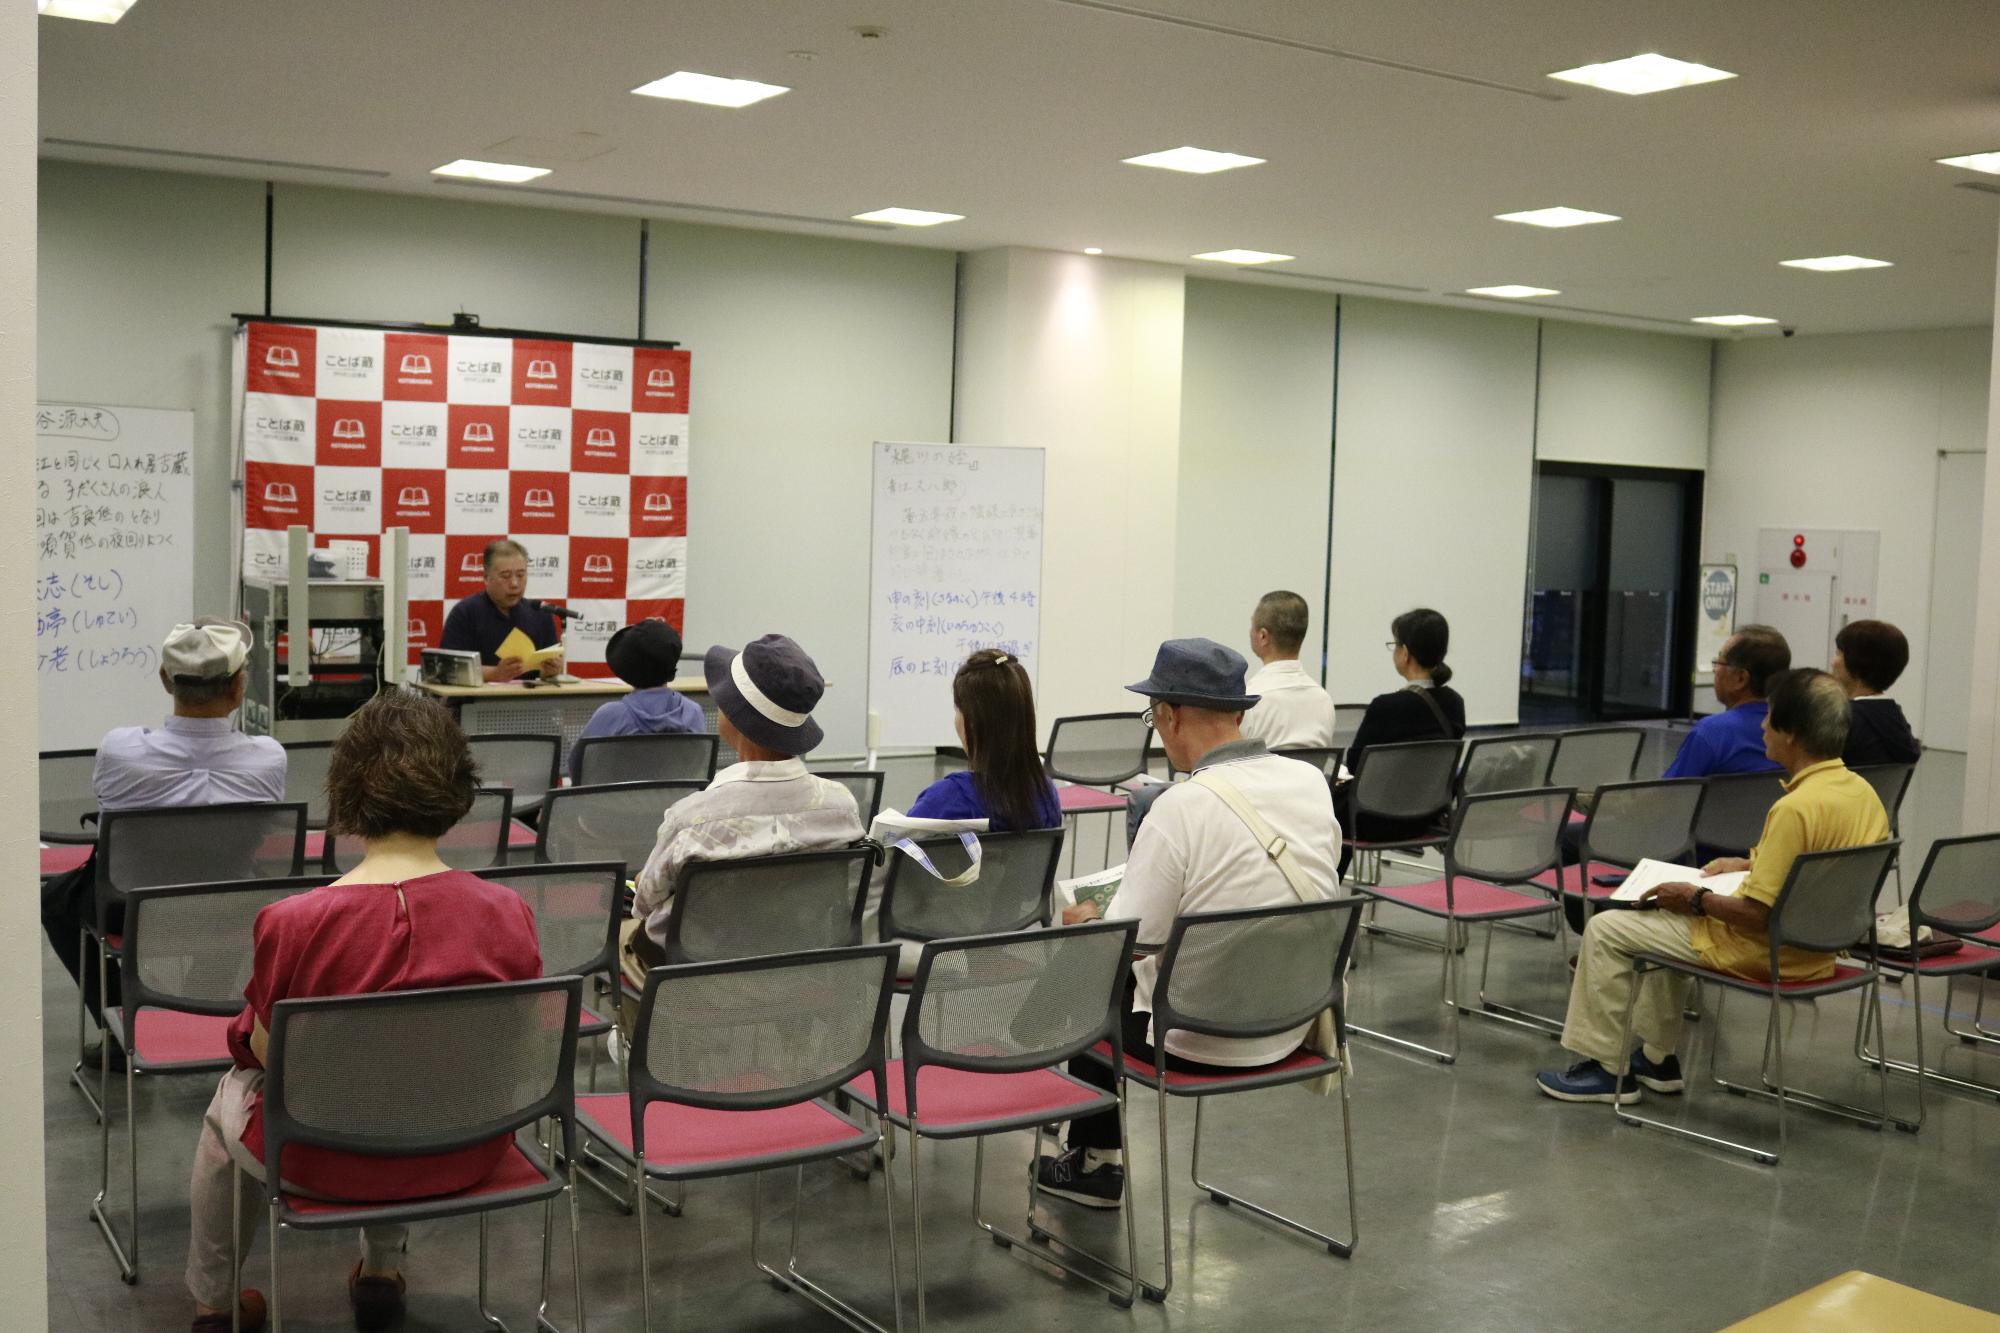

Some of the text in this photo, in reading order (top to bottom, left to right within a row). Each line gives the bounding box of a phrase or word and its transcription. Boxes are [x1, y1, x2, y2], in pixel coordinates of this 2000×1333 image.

[527, 556, 559, 568] とば蔵
[1704, 582, 1731, 594] STAFF
[1705, 596, 1730, 609] ONLY
